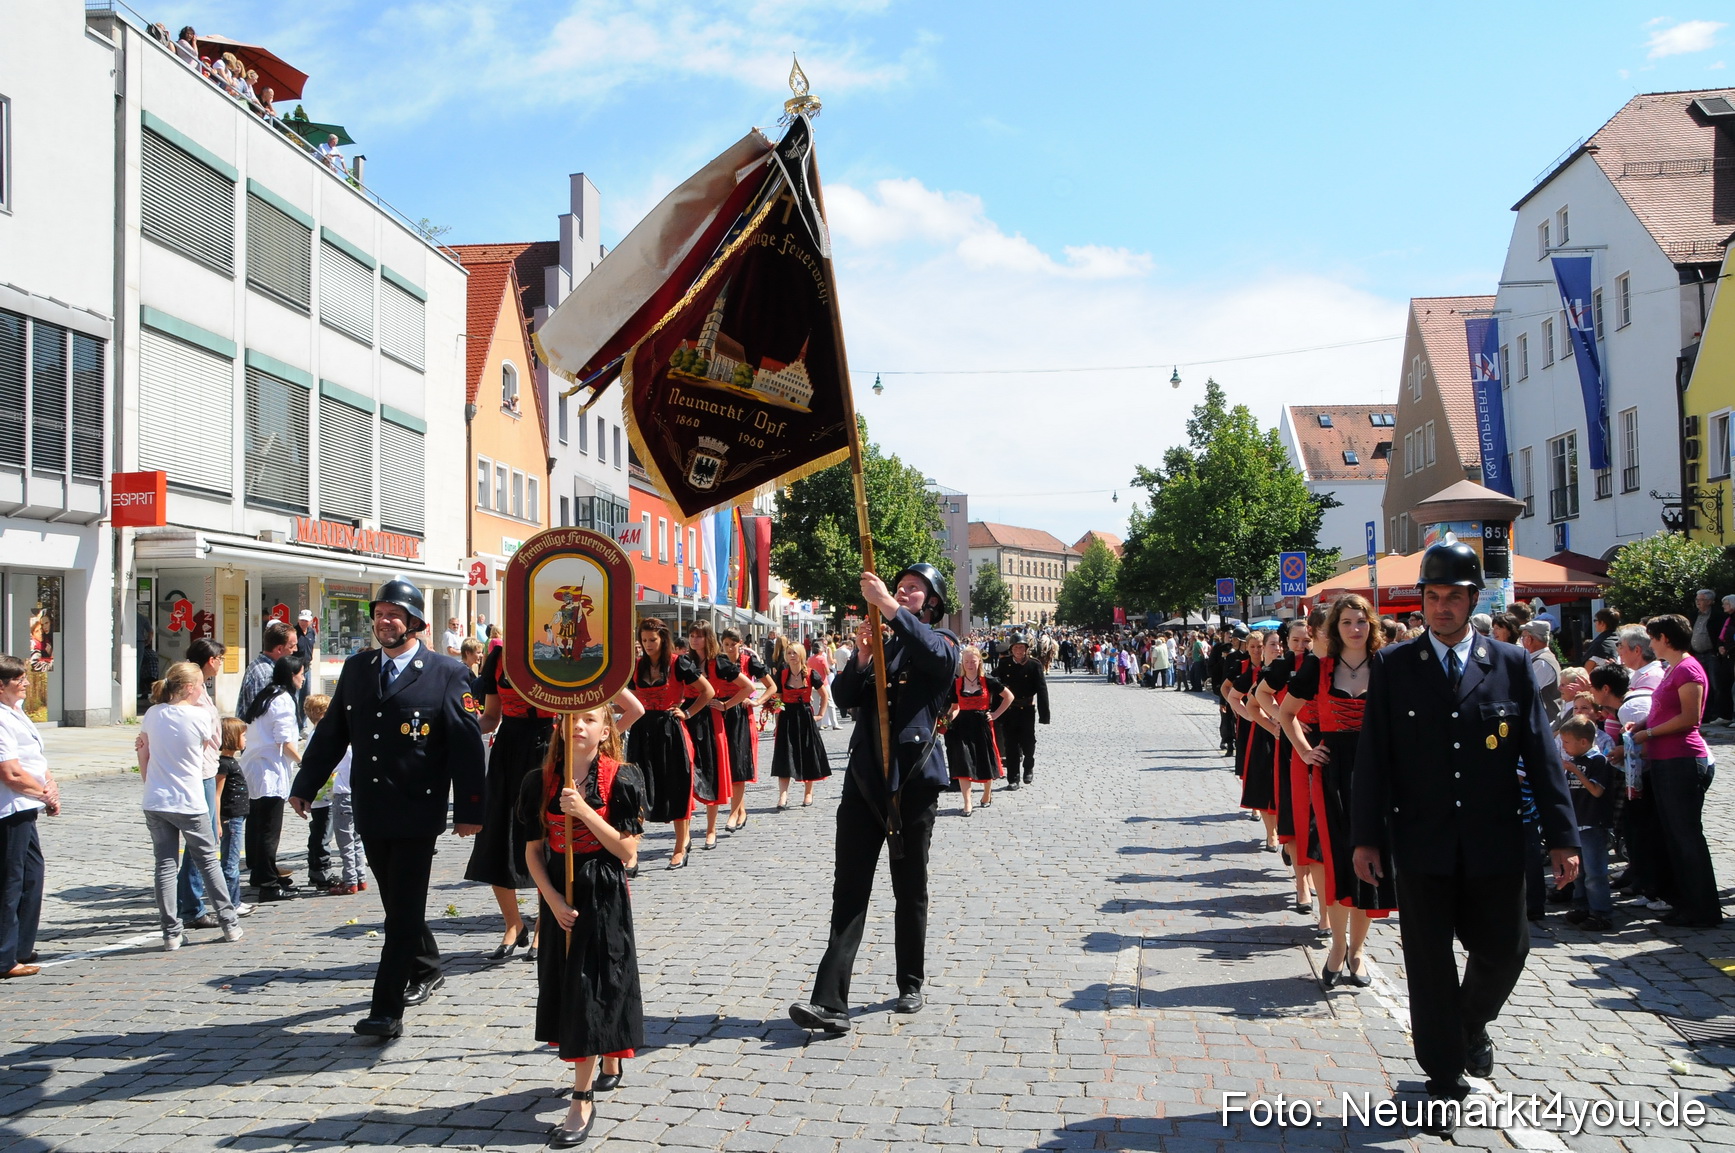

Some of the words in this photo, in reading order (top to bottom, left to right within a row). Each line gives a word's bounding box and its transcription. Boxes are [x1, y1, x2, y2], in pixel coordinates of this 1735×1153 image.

[676, 414, 701, 428] 1860
[738, 432, 765, 449] 1960
[112, 491, 156, 507] ESPRIT
[295, 515, 420, 559] MARIEN-APOTHEKE
[1367, 526, 1374, 551] P
[1484, 526, 1508, 539] 850
[517, 533, 566, 569] Freiwillige
[565, 530, 621, 566] Feuerwehr
[1282, 582, 1304, 592] TAXI
